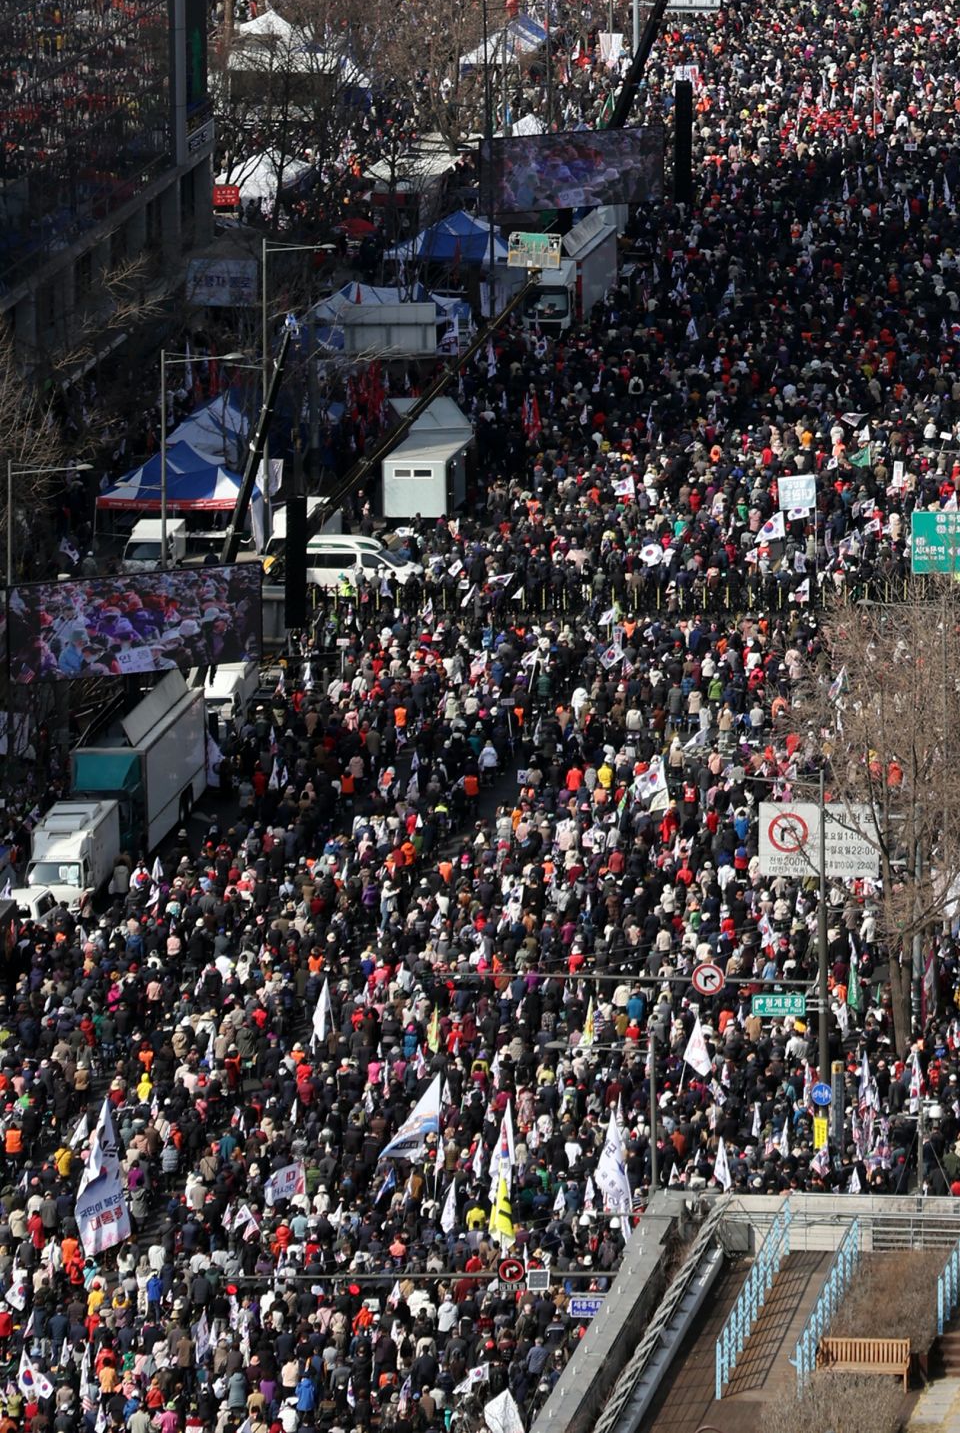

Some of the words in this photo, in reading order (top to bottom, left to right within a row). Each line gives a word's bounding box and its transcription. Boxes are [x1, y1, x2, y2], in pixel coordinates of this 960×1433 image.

[765, 998, 802, 1008] 청계광장
[80, 1200, 103, 1217] 국민이
[90, 1205, 123, 1232] 대통령
